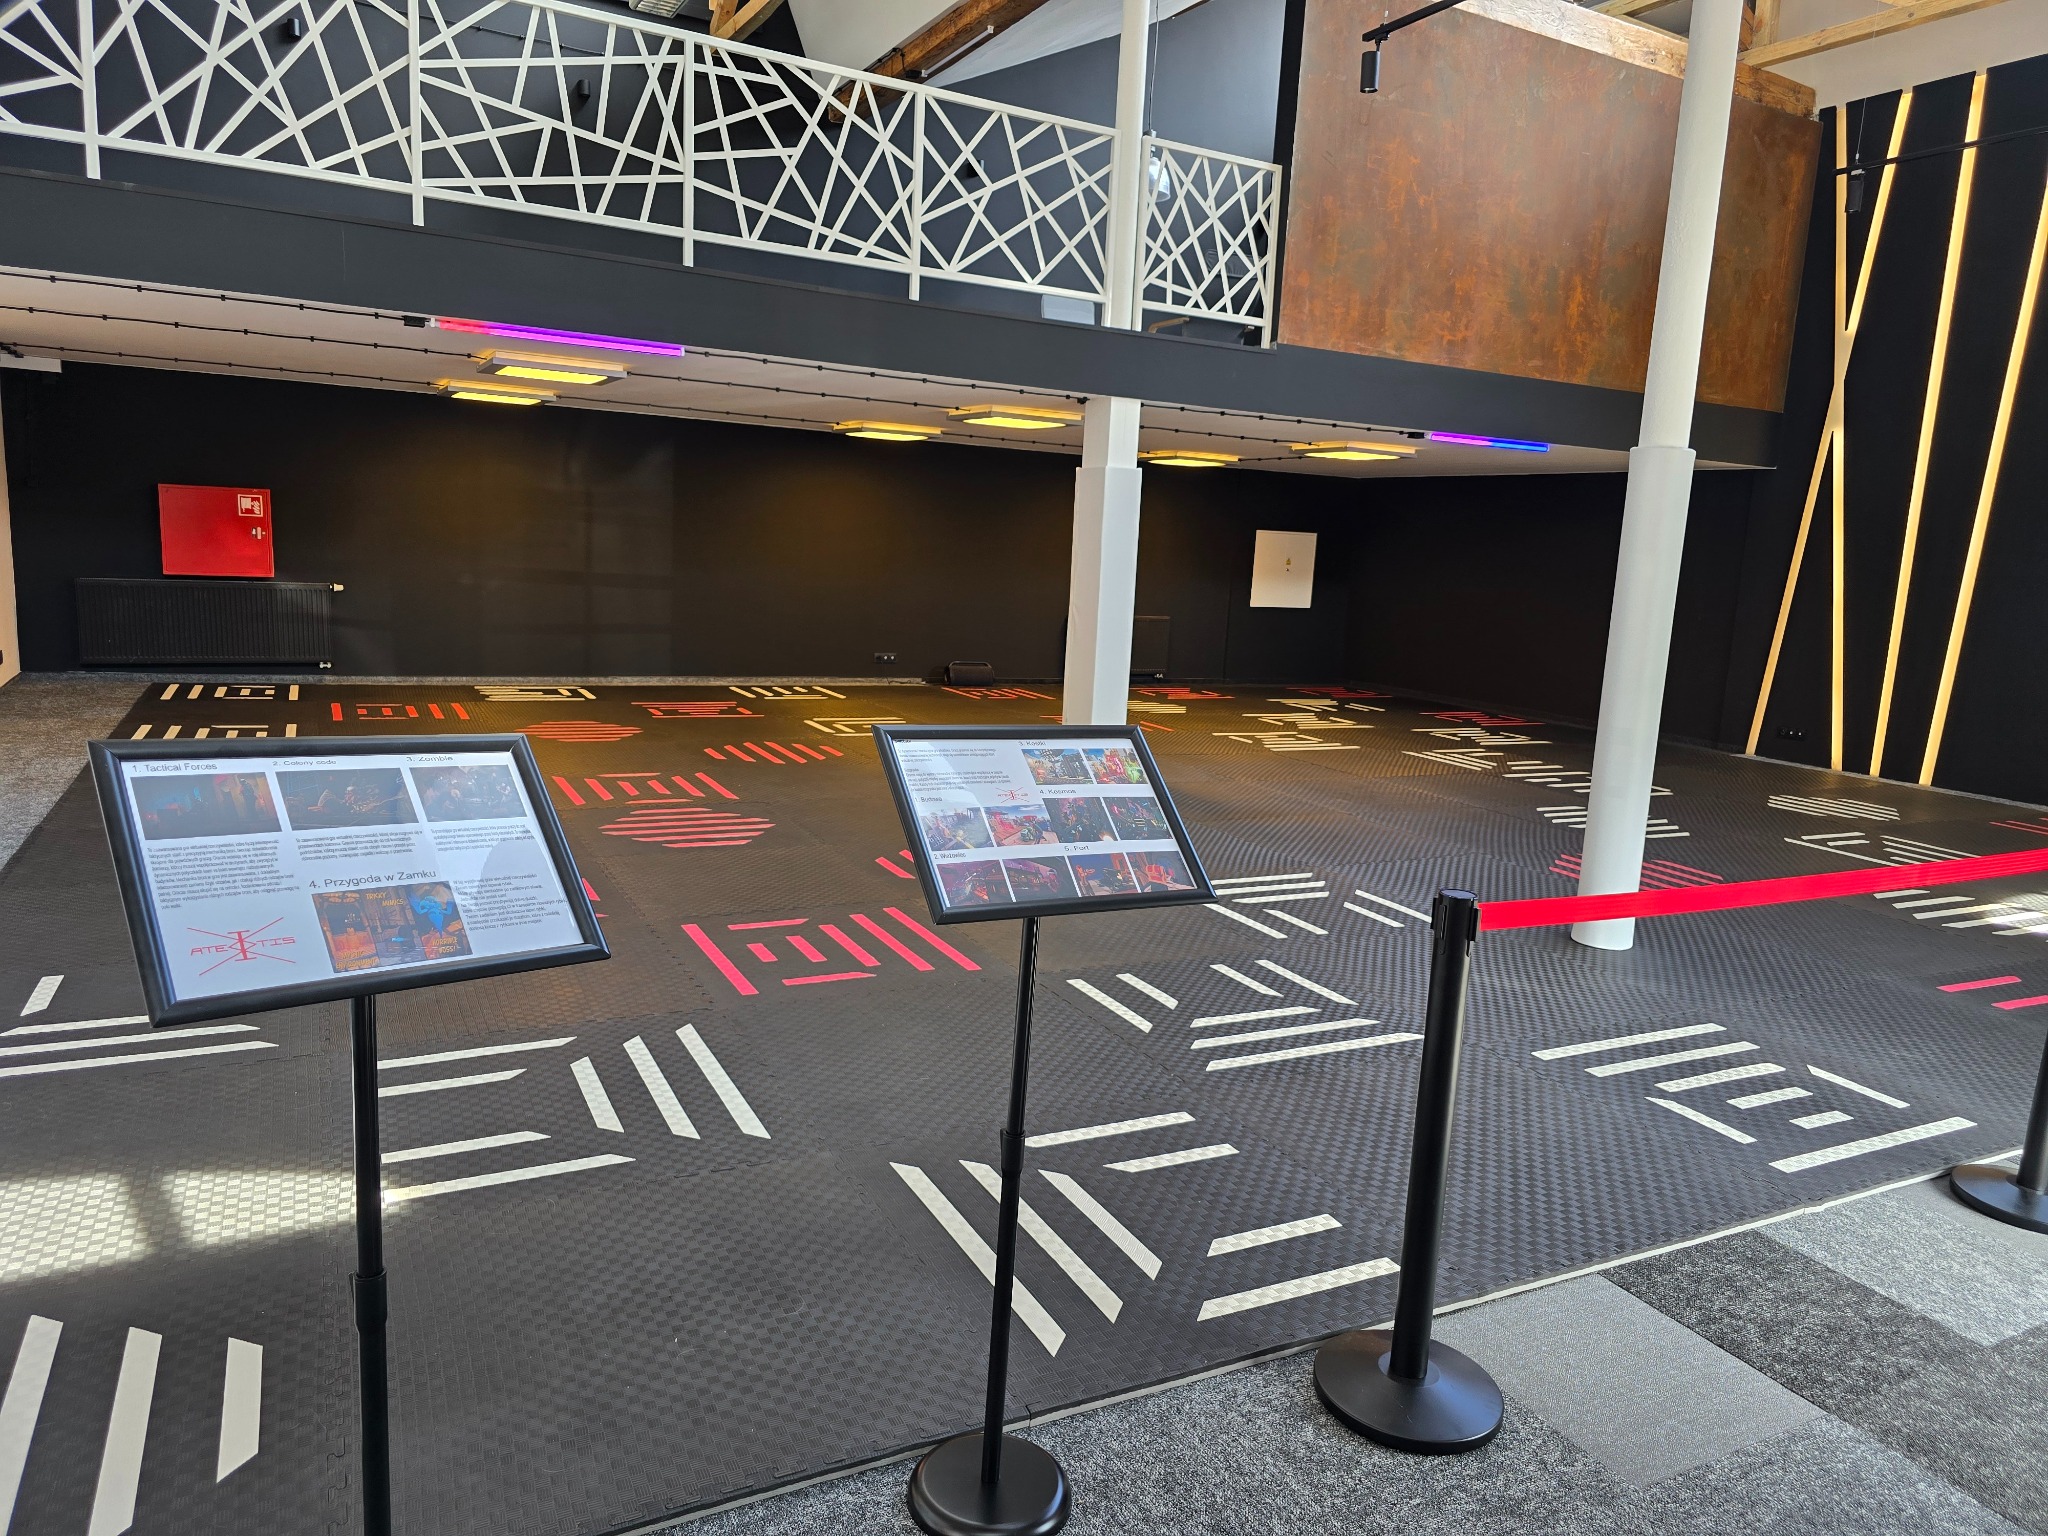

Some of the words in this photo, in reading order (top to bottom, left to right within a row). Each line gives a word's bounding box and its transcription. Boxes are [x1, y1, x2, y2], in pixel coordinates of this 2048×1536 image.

[132, 764, 141, 773] 1.
[145, 763, 181, 773] Tactical
[184, 762, 218, 771] Forces
[283, 759, 313, 767] Colony
[309, 880, 321, 889] 4.
[324, 875, 382, 889] Przygoda
[384, 874, 395, 882] w
[397, 870, 437, 881] Zamku
